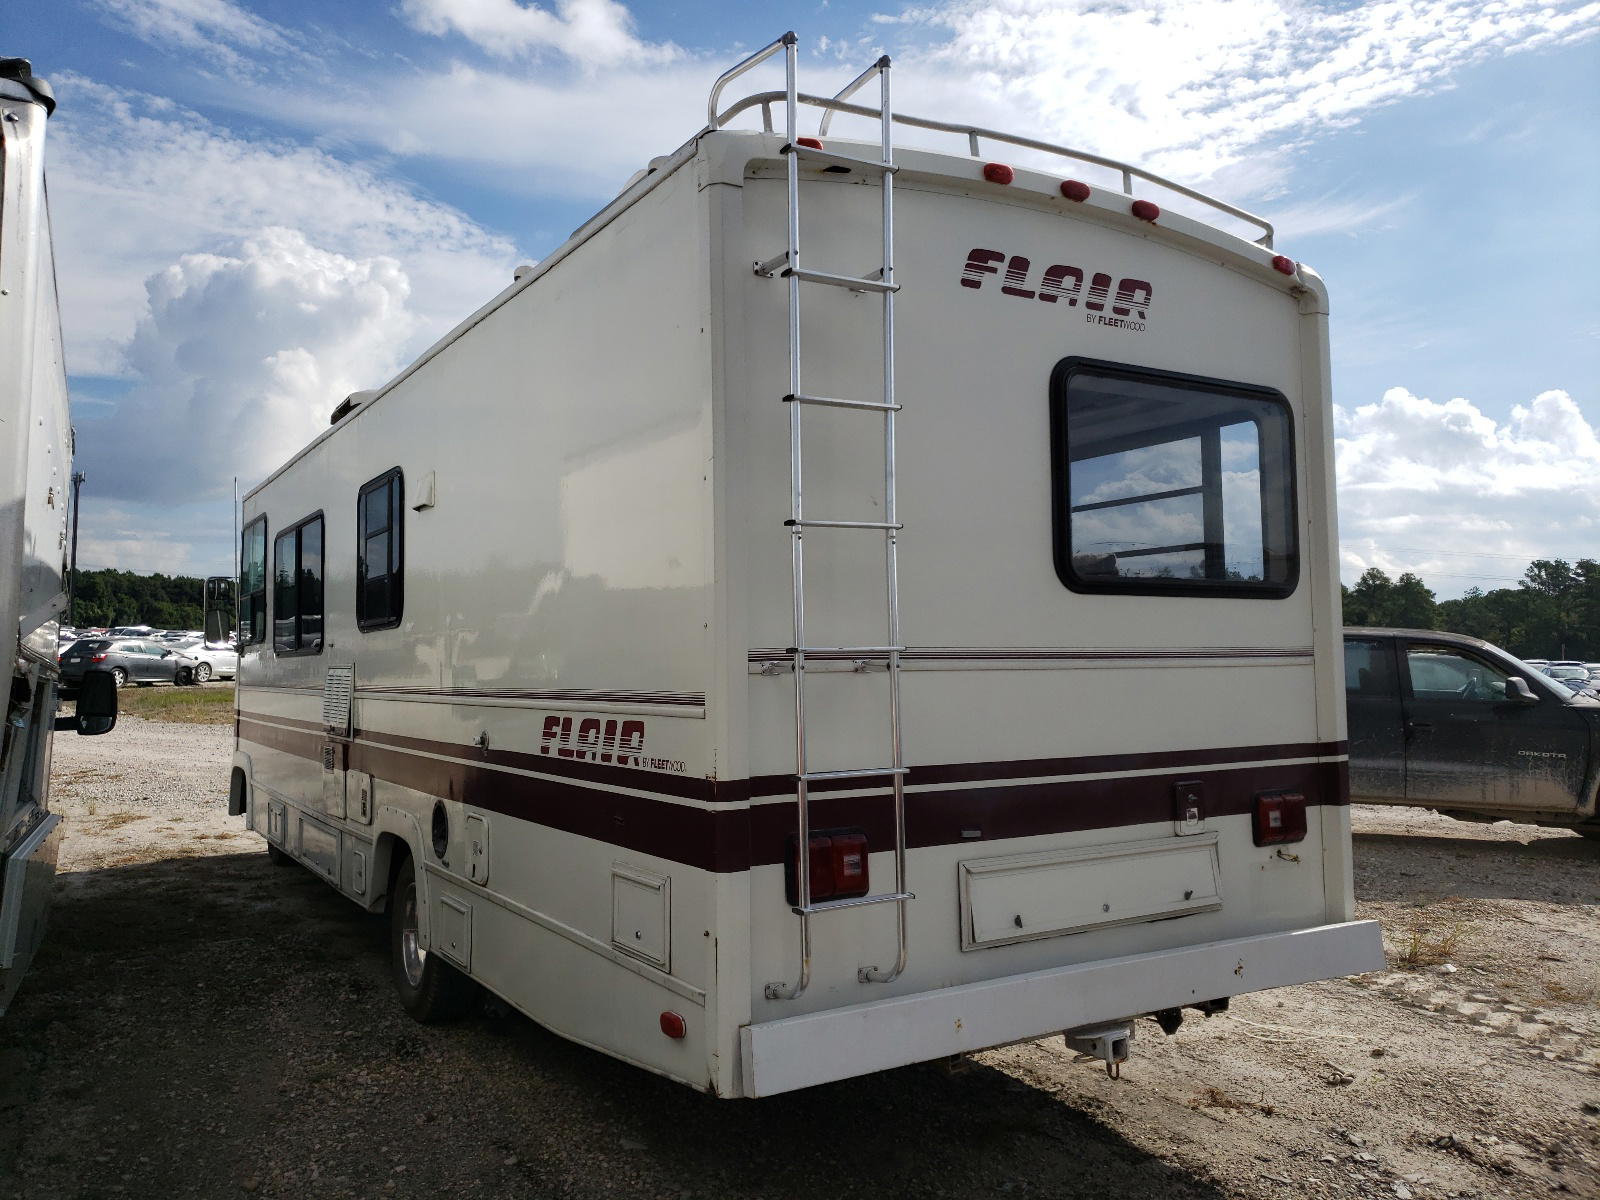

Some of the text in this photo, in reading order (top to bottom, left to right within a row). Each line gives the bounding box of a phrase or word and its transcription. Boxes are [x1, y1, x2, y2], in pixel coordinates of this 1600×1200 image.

[960, 248, 1153, 320] FLAIR
[1086, 313, 1146, 332] BY FLEETWOOD
[540, 715, 645, 767] FLAIR
[642, 757, 650, 768] BY
[1518, 750, 1567, 759] DAKOTA
